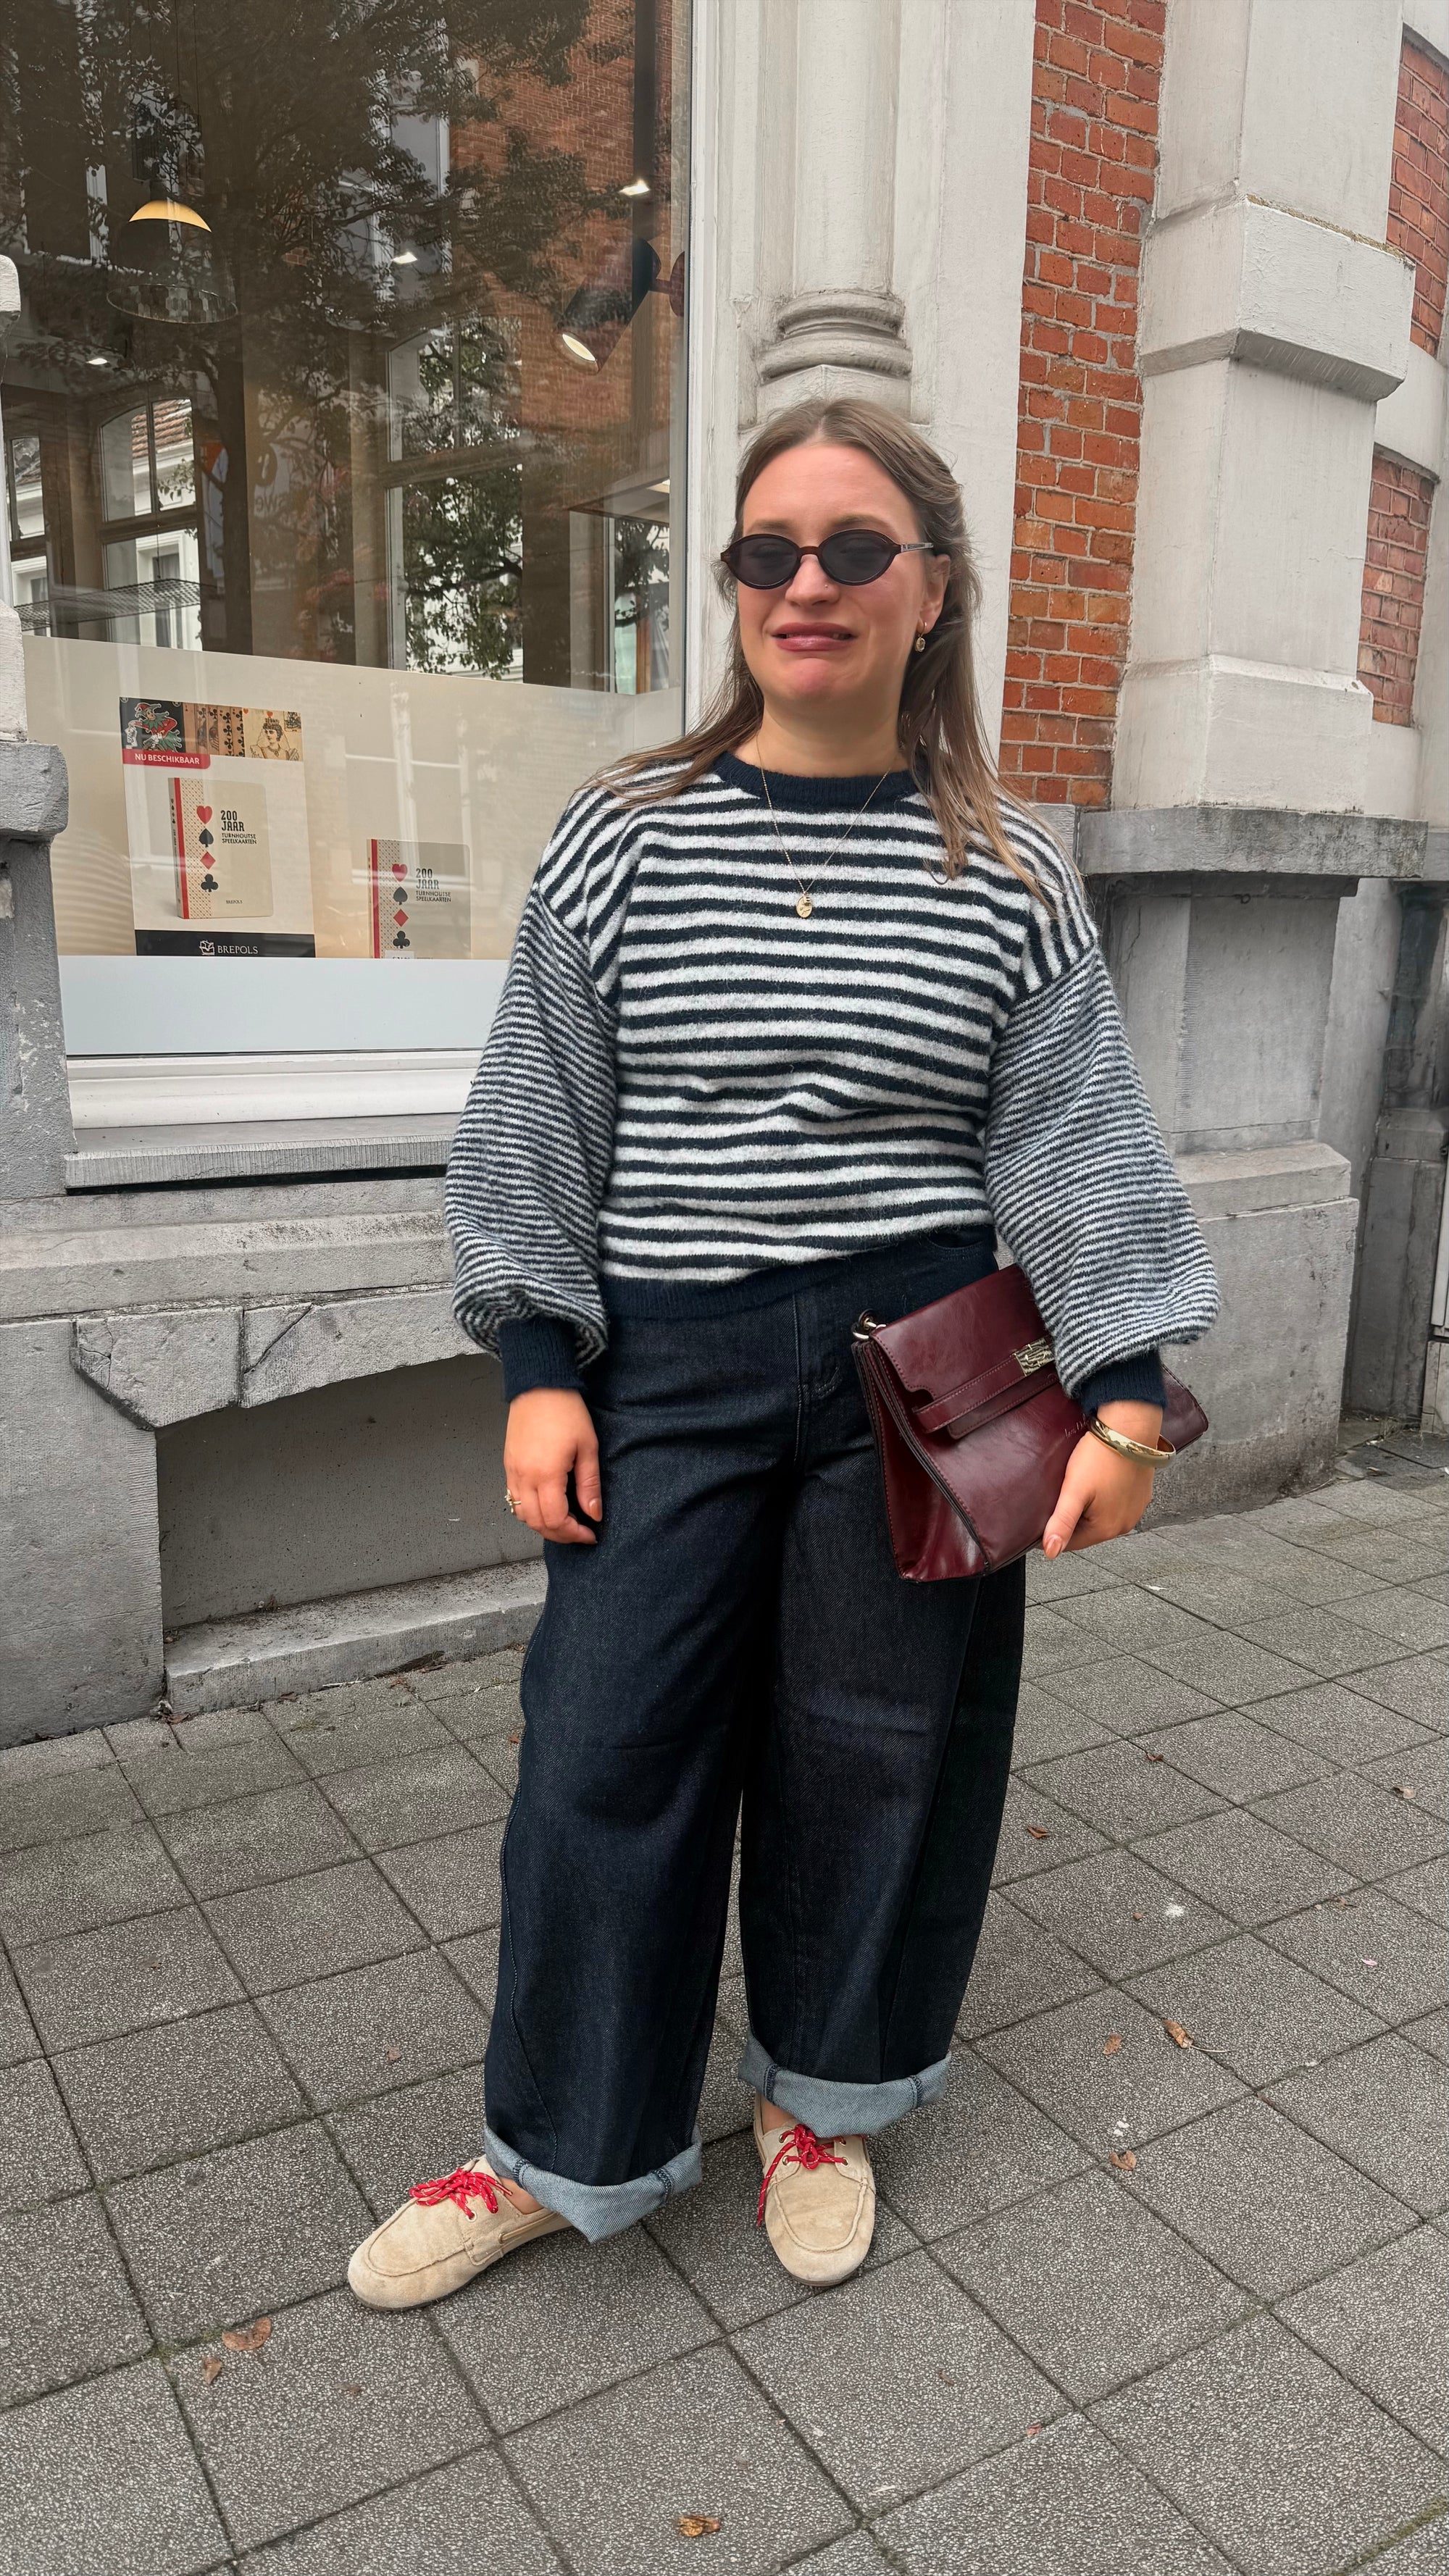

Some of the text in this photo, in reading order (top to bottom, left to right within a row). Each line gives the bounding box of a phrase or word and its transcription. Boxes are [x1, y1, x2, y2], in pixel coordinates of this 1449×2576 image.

[148, 754, 200, 764] BESCHIKBAAR
[220, 810, 238, 821] 200
[221, 821, 245, 832] JAAR
[416, 868, 433, 879] 200
[416, 879, 440, 890] JAAR
[217, 945, 259, 955] BREPOLS
